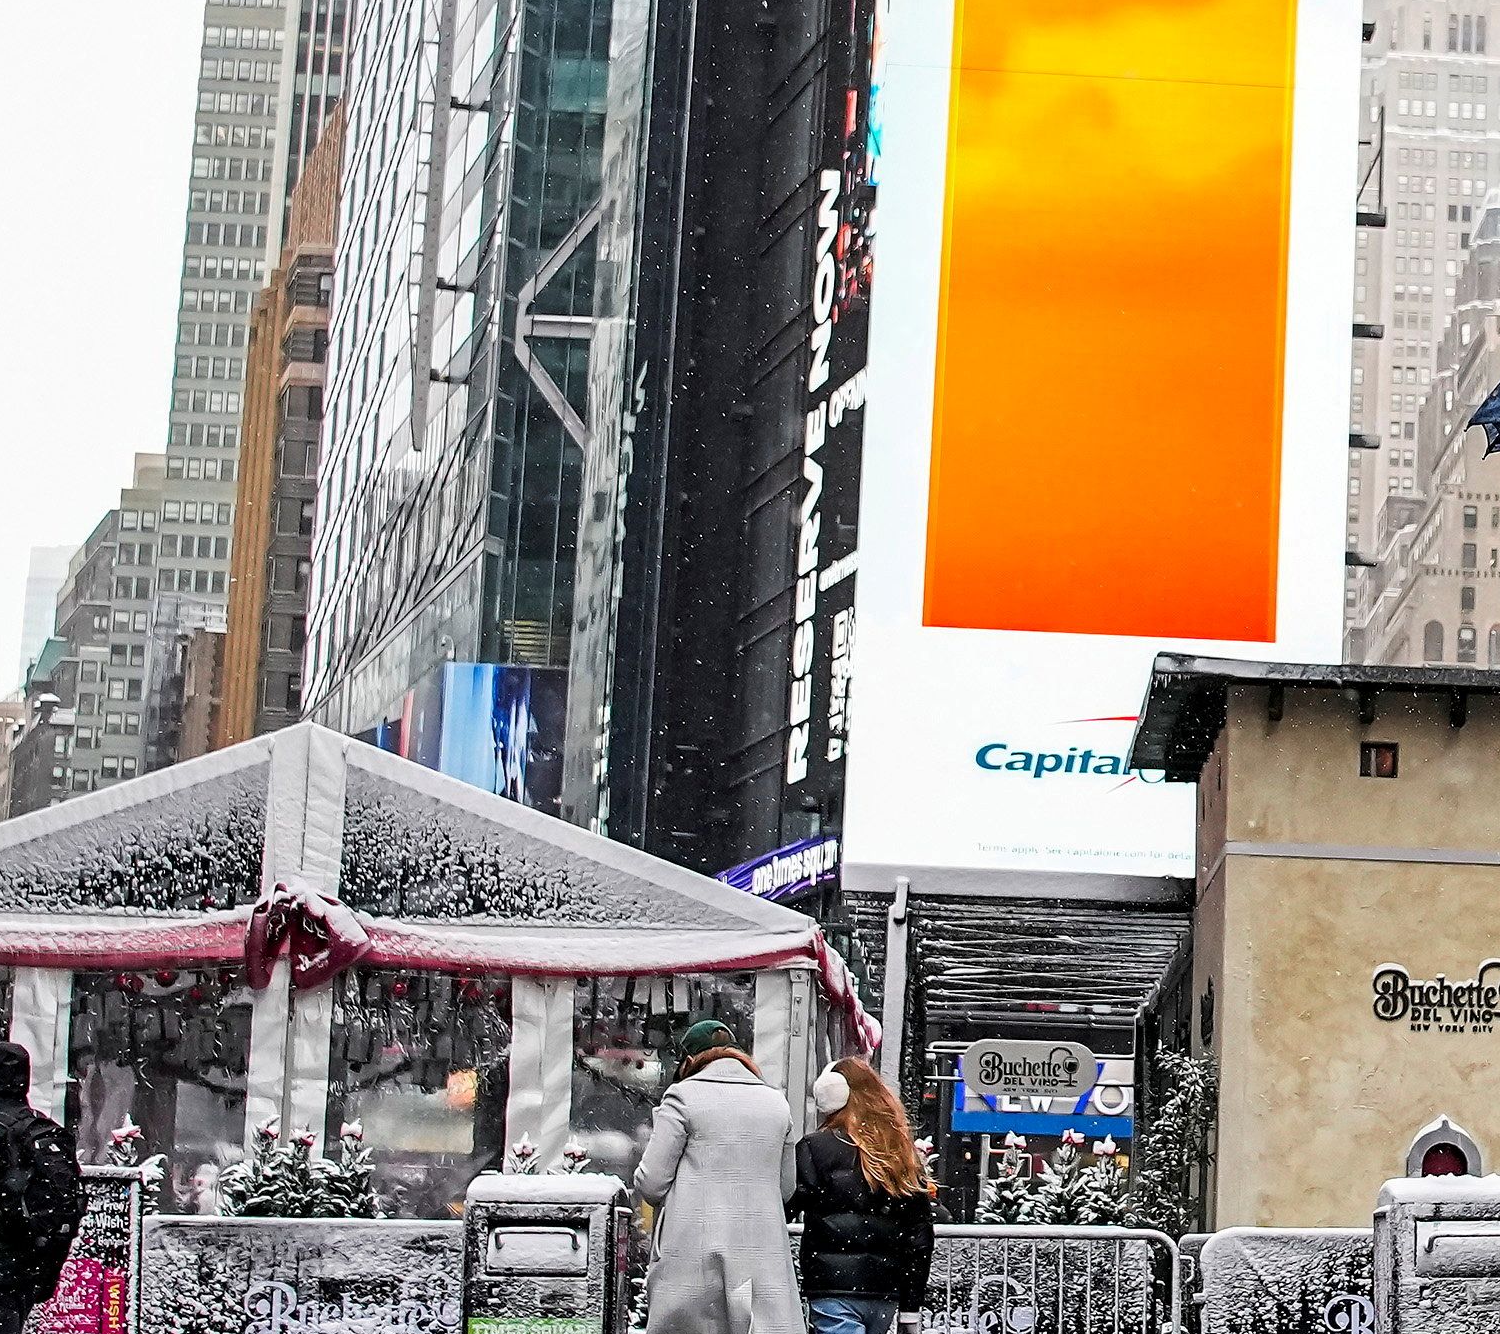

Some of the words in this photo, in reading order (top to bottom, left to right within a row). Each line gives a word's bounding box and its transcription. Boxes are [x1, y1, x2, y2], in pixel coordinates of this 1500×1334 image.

[808, 167, 842, 394] NOW
[786, 400, 827, 786] RESERVE
[1372, 965, 1500, 1022] Buchette
[1410, 1008, 1442, 1022] DEL
[1449, 1008, 1494, 1023] VINO
[979, 1050, 1062, 1086] Buchette
[1003, 1078, 1025, 1086] DEL
[1030, 1078, 1060, 1086] VINO
